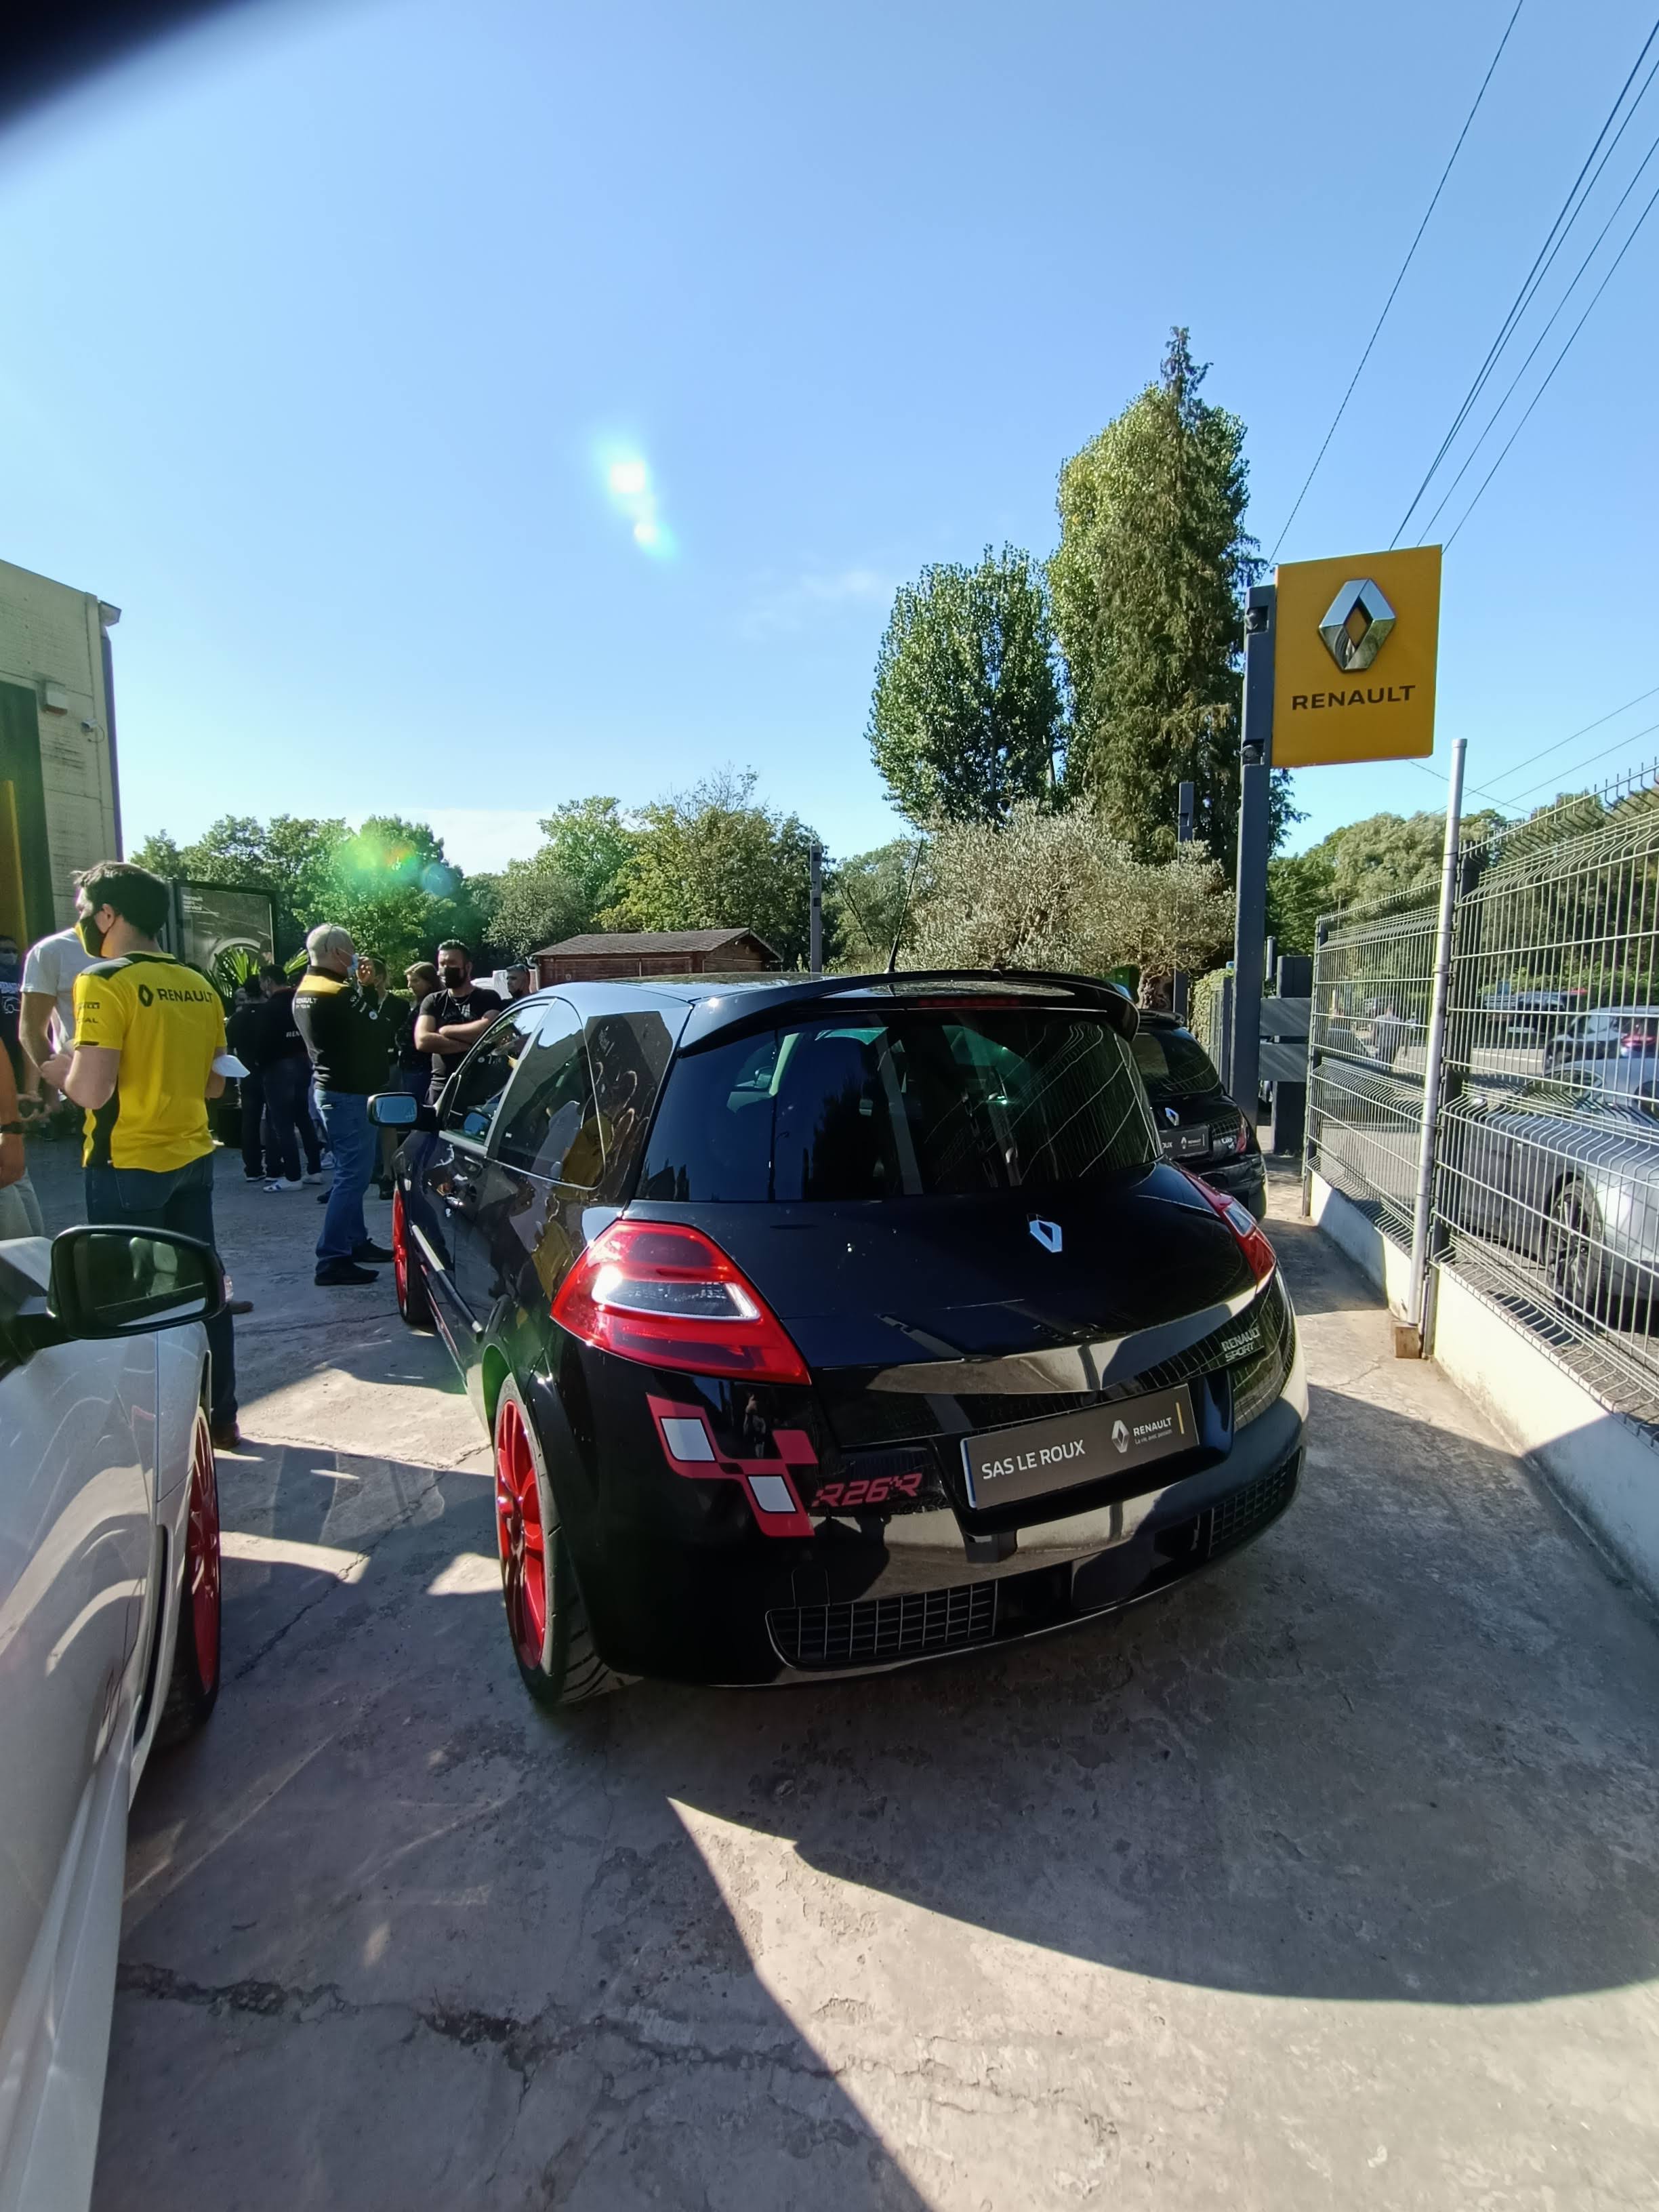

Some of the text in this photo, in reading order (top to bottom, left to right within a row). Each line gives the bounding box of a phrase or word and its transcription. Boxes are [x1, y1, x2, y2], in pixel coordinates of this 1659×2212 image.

[1291, 684, 1416, 711] RENAULT
[157, 988, 213, 1003] RENAULT
[1221, 1326, 1261, 1352] RENAULT
[1225, 1342, 1254, 1362] SPORT
[1133, 1417, 1172, 1436] RENAULT
[981, 1439, 1086, 1479] SAS LE ROUX
